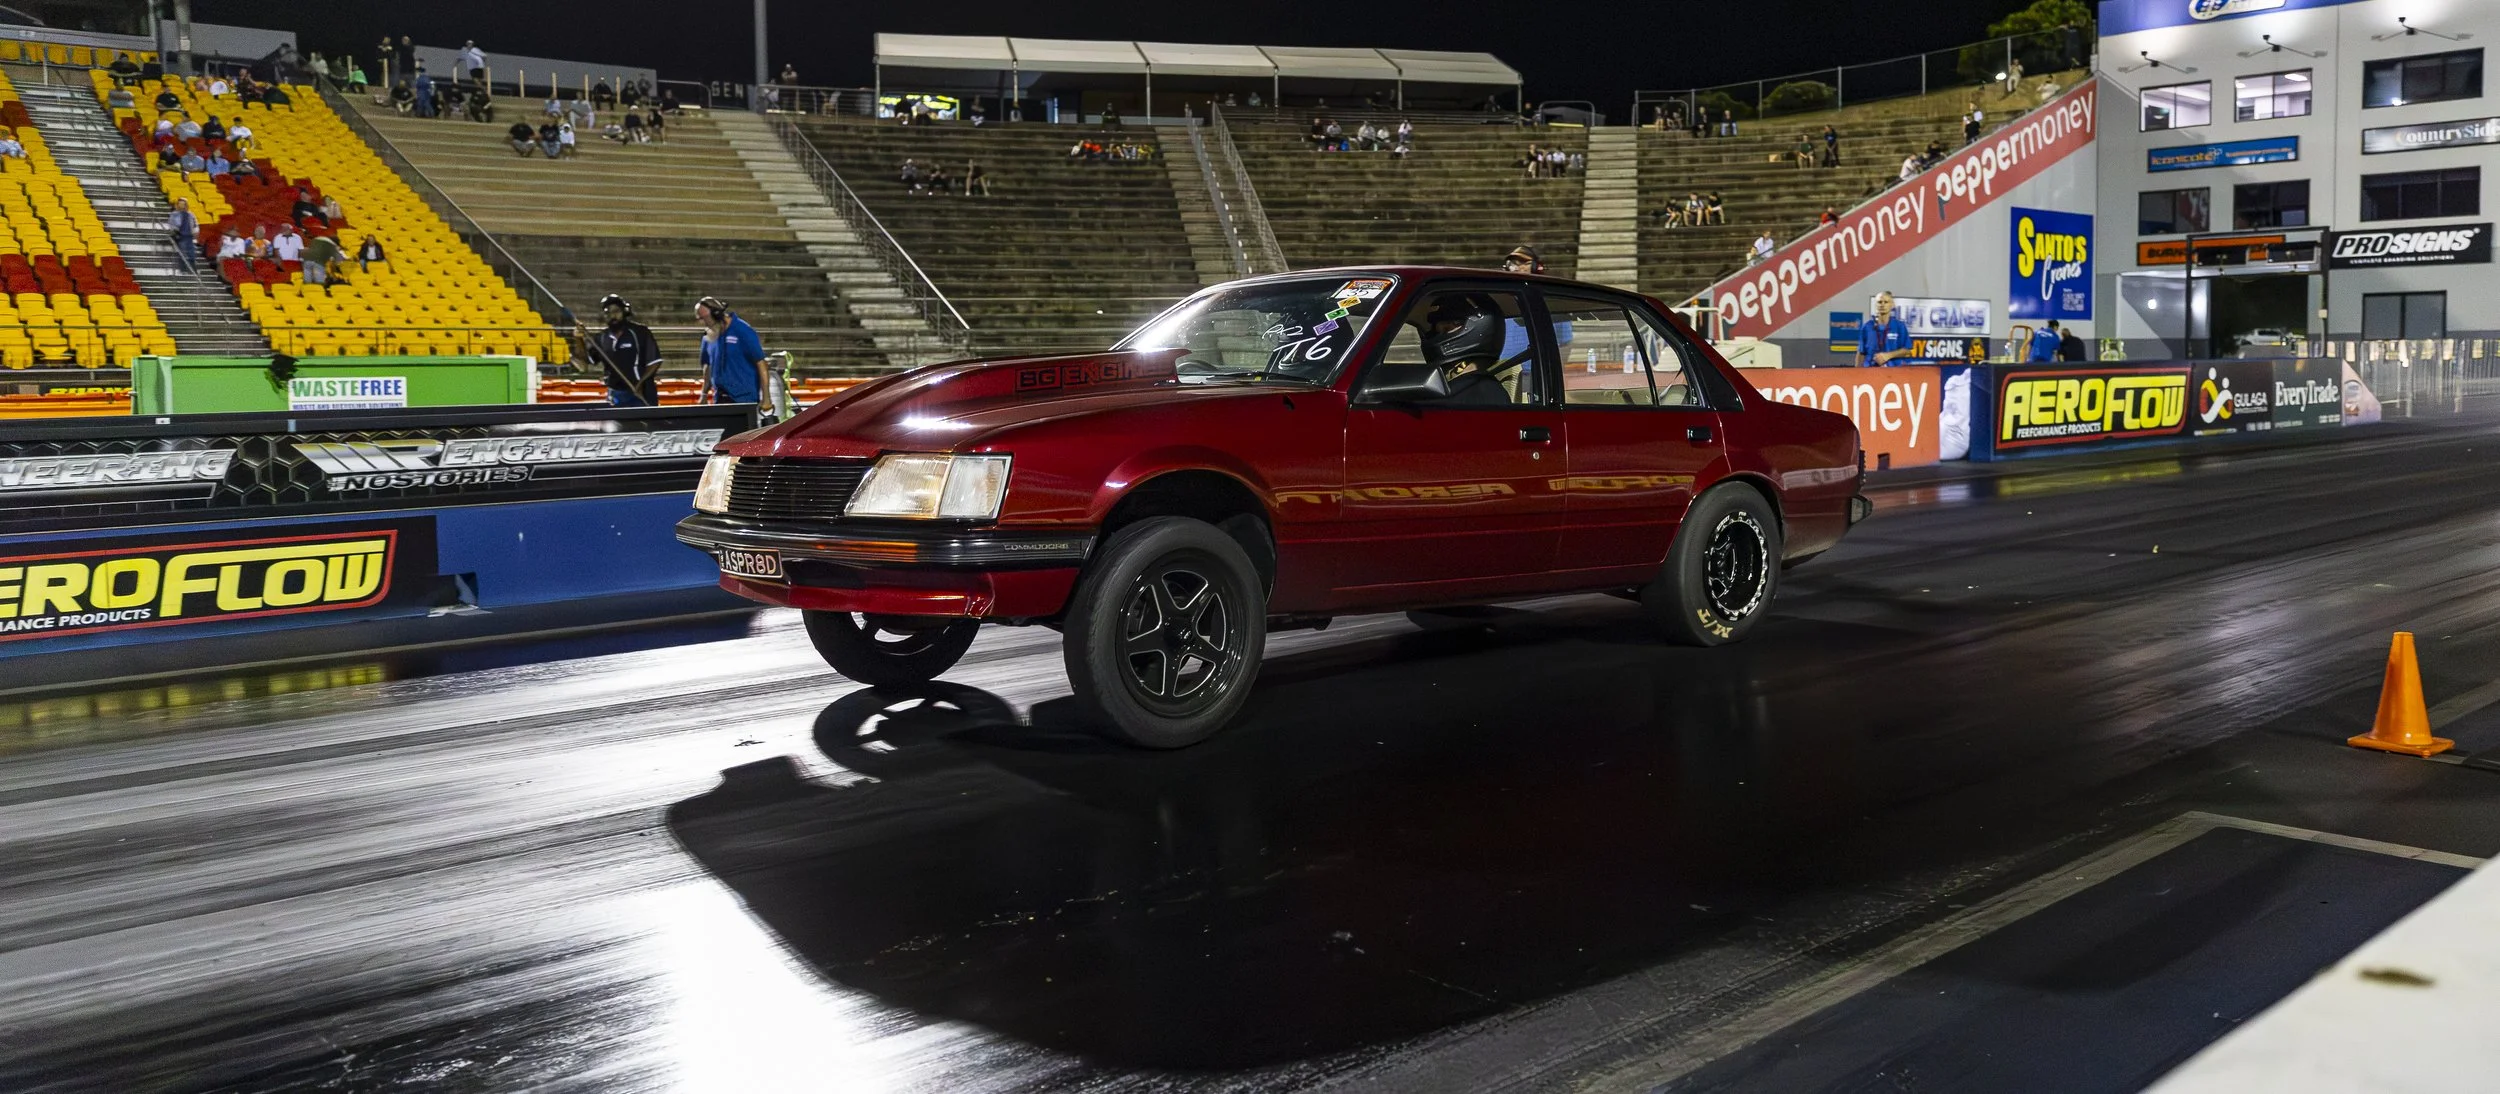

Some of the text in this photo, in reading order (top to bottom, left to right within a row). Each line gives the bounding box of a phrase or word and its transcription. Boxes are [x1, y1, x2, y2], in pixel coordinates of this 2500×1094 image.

[1936, 91, 2093, 221] peppermoney
[2333, 230, 2475, 258] PROSIGNS
[1718, 186, 1925, 342] peppermoney
[1930, 307, 1985, 328] CRANES
[292, 379, 403, 397] WASTEFREE
[2234, 392, 2268, 408] GULAGA
[2275, 378, 2339, 412] EveryTrade
[2002, 375, 2187, 440] AEROFLOW
[440, 429, 724, 467] ENGINEERING
[725, 550, 776, 575] ASPR8D
[0, 608, 152, 633] ANCE PRODUCTS
